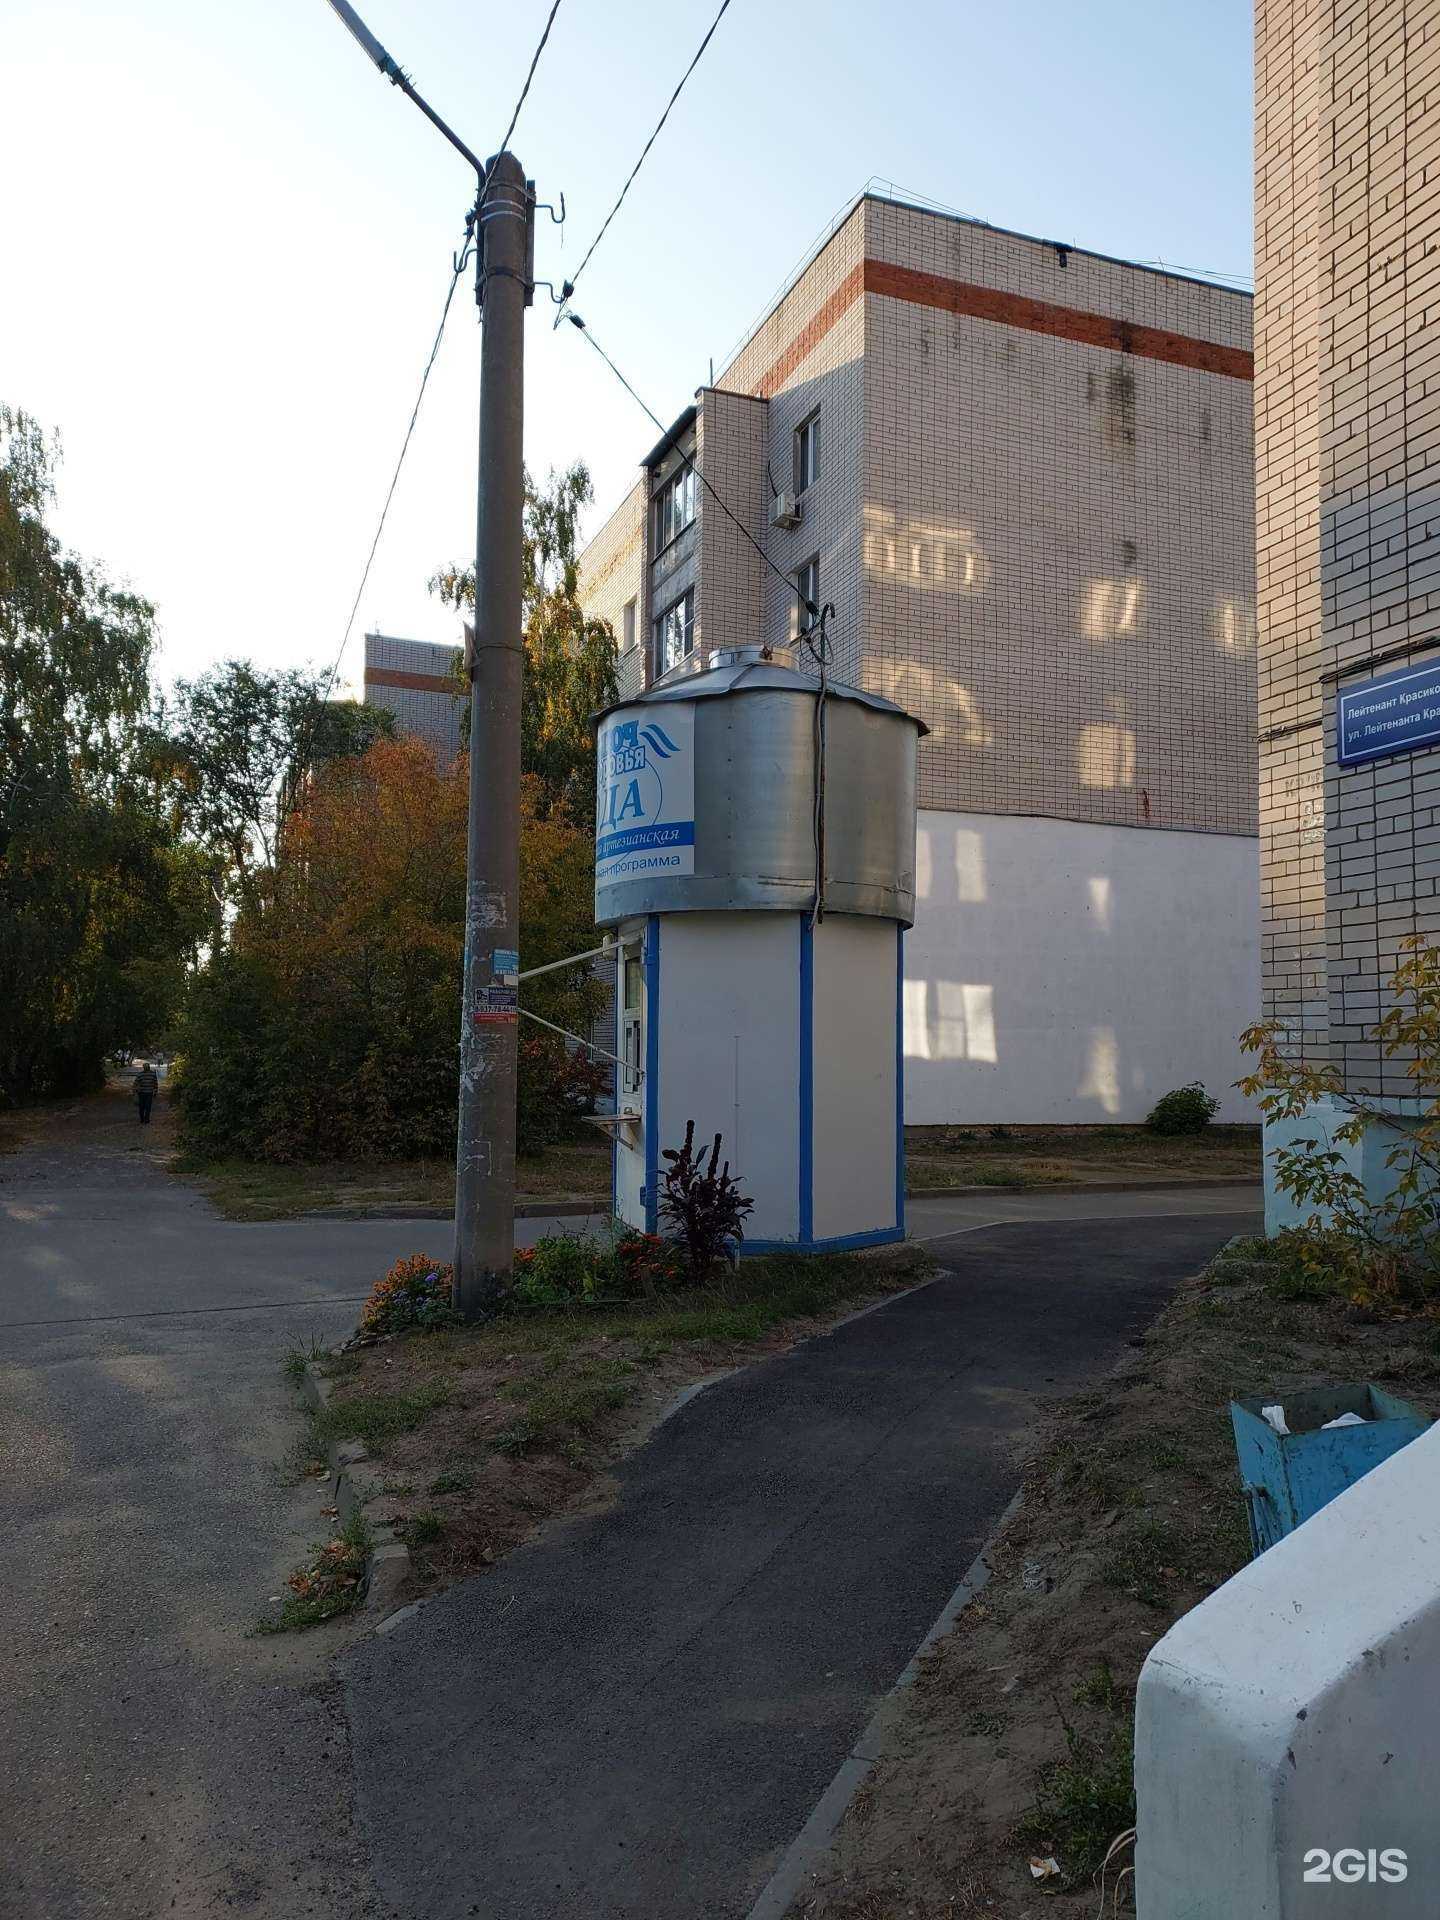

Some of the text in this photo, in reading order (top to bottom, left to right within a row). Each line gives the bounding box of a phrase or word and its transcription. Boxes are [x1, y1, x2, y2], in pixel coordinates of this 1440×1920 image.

[1347, 697, 1397, 720] Лейтенант
[1348, 731, 1362, 743] ул.
[1364, 713, 1421, 736] Лейтенанта
[599, 778, 645, 832] ДА
[610, 855, 680, 876] программа
